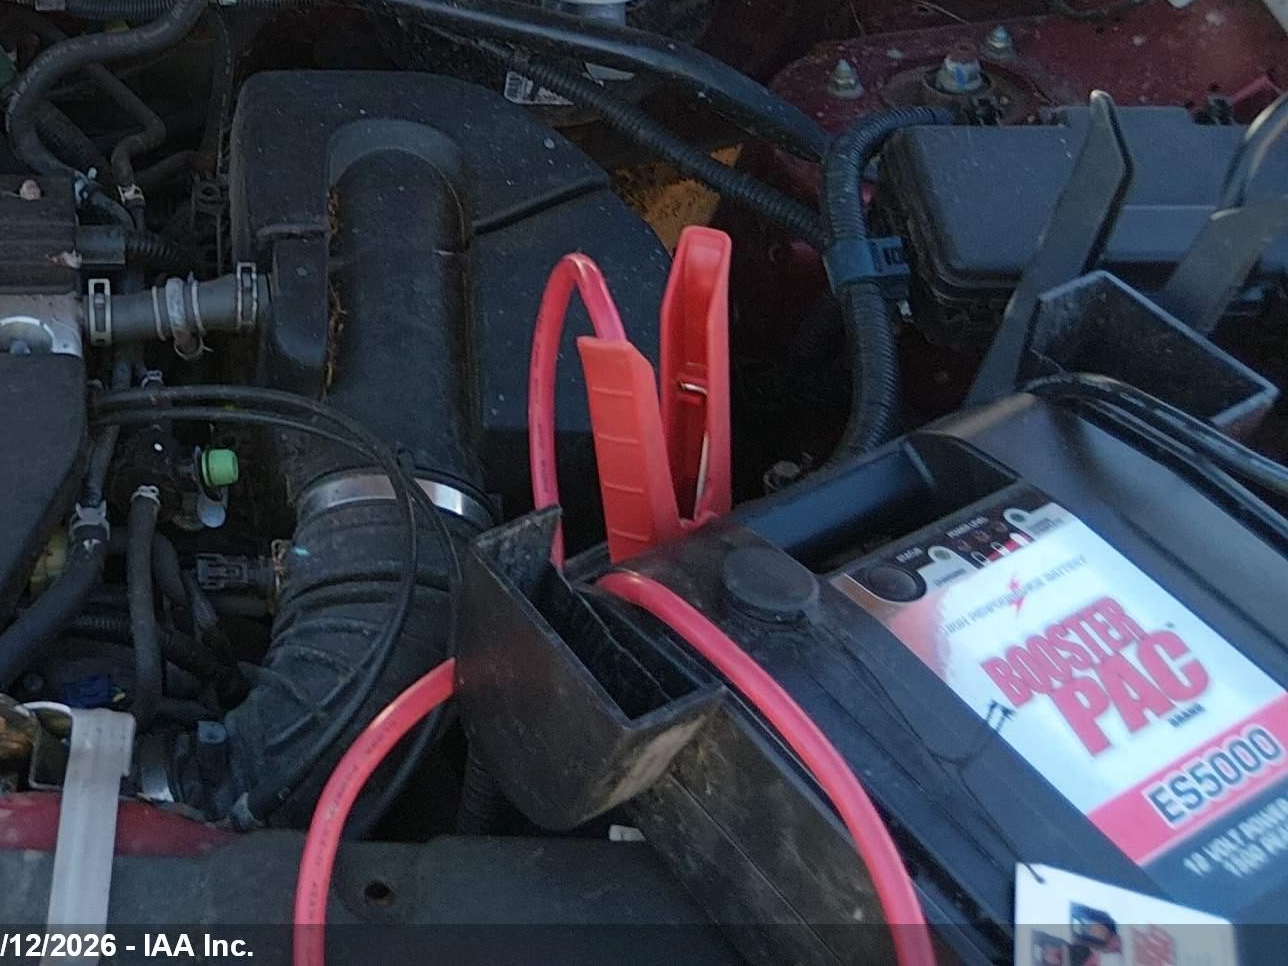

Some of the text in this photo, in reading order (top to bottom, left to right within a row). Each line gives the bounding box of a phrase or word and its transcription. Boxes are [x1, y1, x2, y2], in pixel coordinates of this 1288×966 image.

[979, 595, 1148, 708] BOOSTER
[1047, 629, 1209, 757] PAC
[1146, 727, 1281, 824] ES5000
